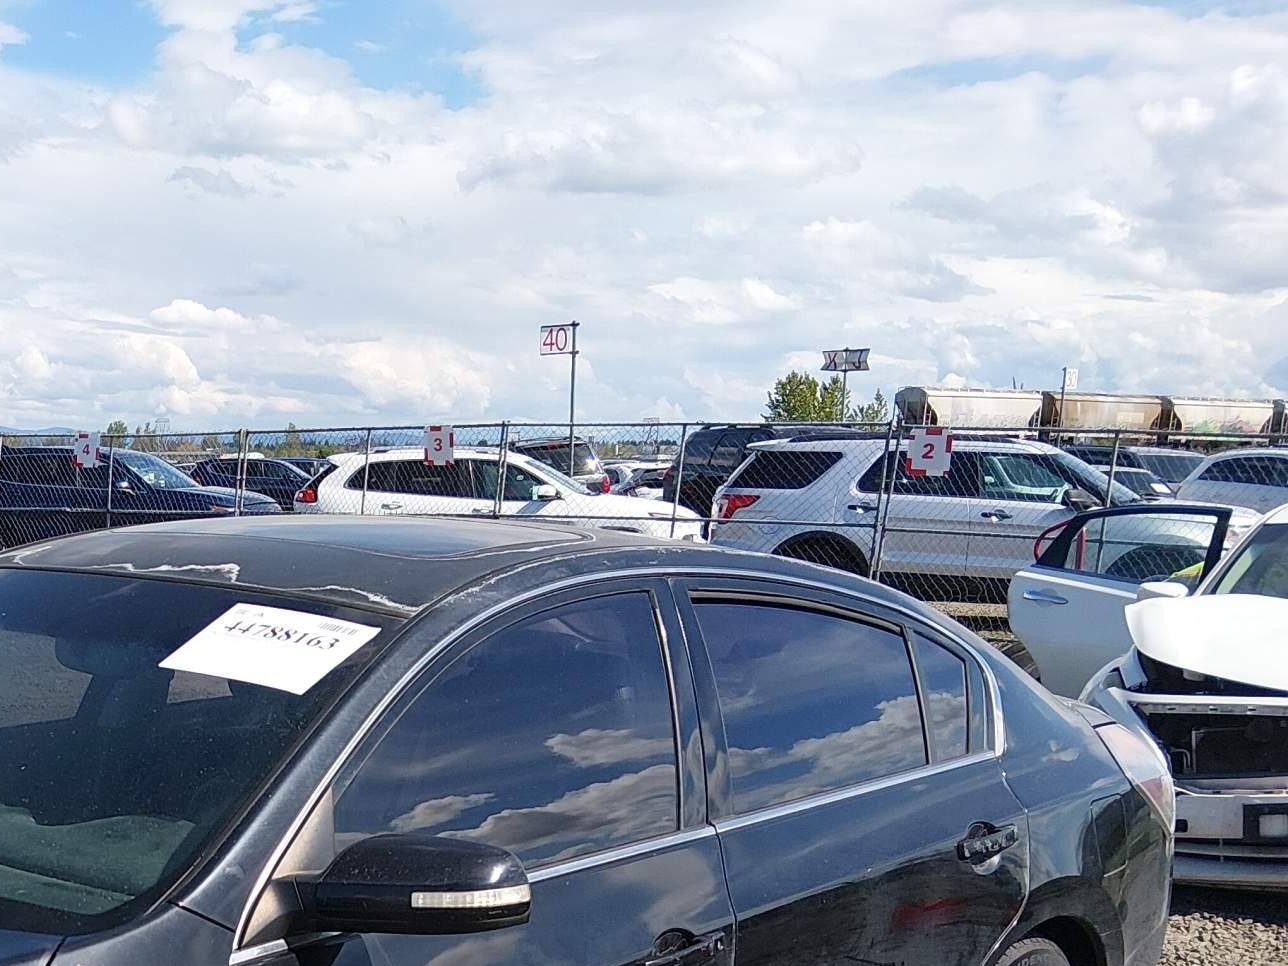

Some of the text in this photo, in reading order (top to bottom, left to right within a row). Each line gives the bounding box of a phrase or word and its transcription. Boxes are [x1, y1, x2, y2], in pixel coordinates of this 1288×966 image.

[542, 327, 568, 352] 40
[82, 443, 90, 456] 4
[433, 437, 443, 452] 3
[921, 442, 935, 459] 2
[223, 619, 341, 651] 44788163
